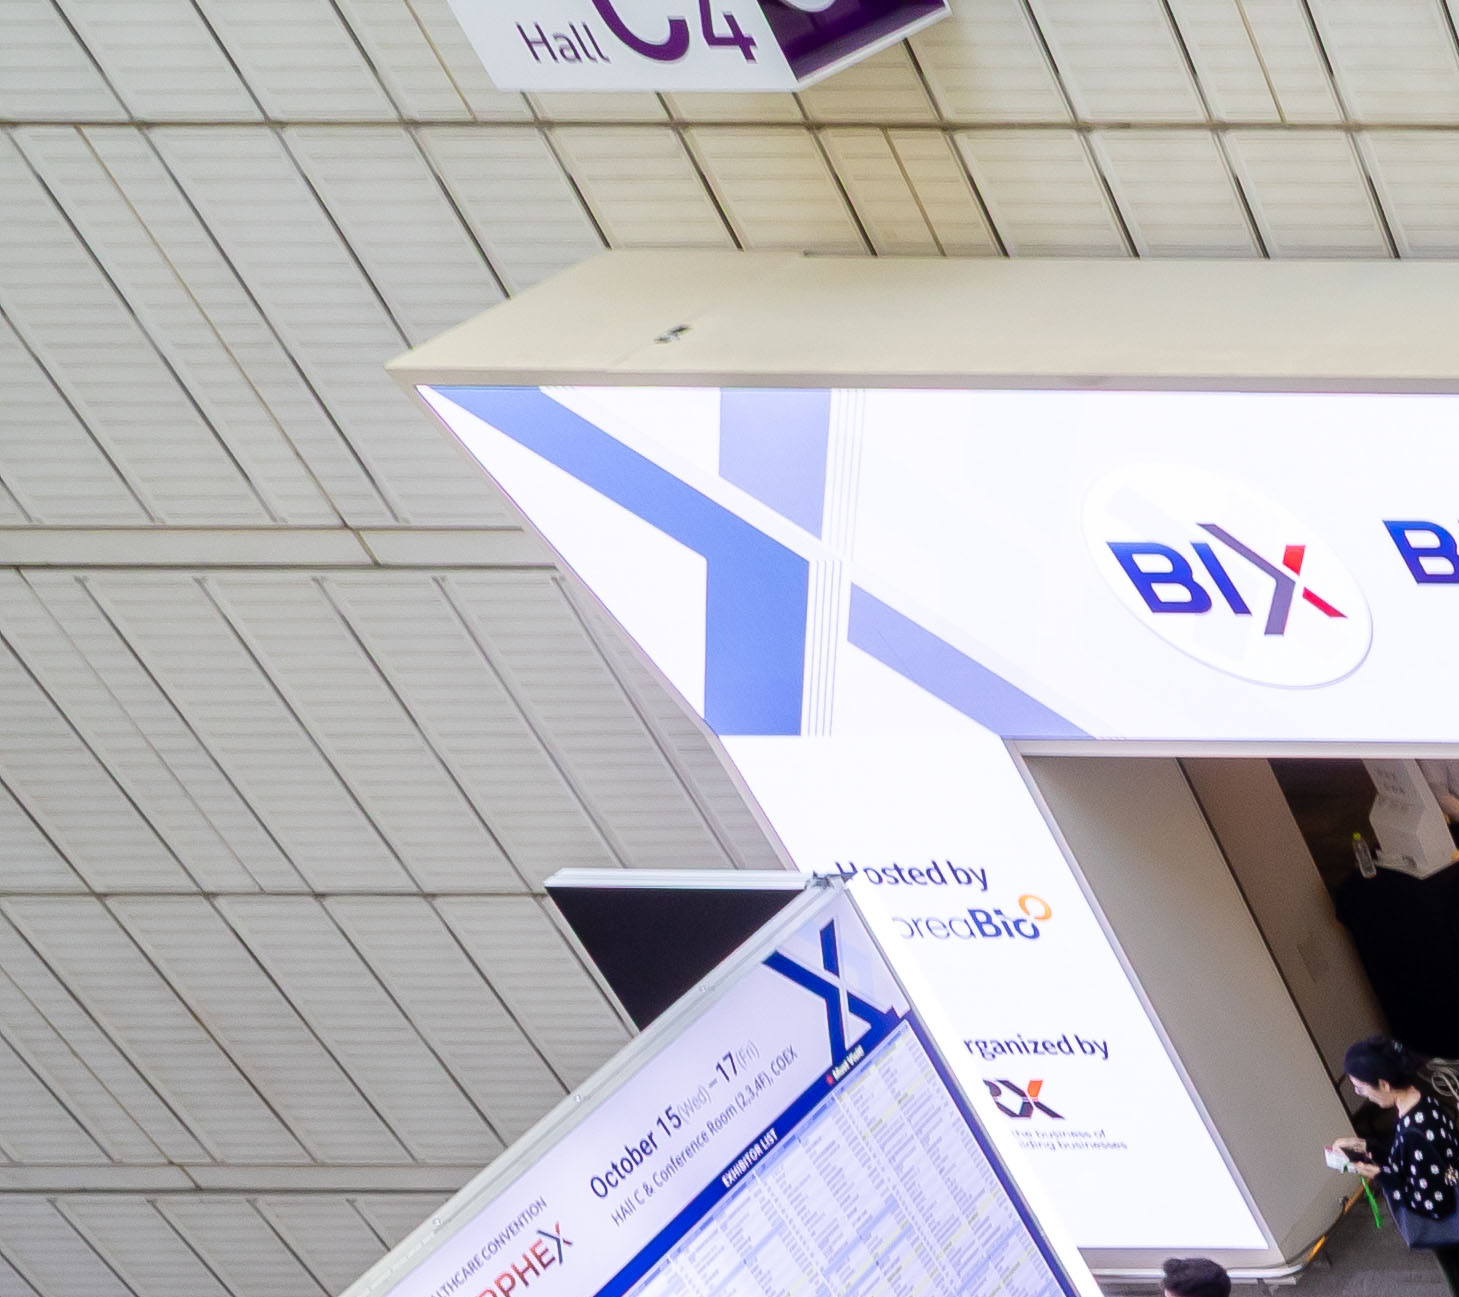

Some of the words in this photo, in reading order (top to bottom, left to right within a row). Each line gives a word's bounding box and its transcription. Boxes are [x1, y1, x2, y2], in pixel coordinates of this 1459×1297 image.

[516, 21, 610, 65] Hall
[1107, 522, 1348, 636] BIX
[947, 861, 988, 891] by
[964, 1033, 1073, 1060] rganized
[1074, 1033, 1109, 1060] by
[650, 1128, 711, 1189] Conference
[706, 1101, 739, 1137] Room
[768, 1044, 799, 1078] COEX
[589, 1129, 659, 1200] October
[720, 1142, 763, 1188] EXHIBITOR
[758, 1127, 779, 1151] LIST
[478, 1194, 549, 1261] CONVENTION
